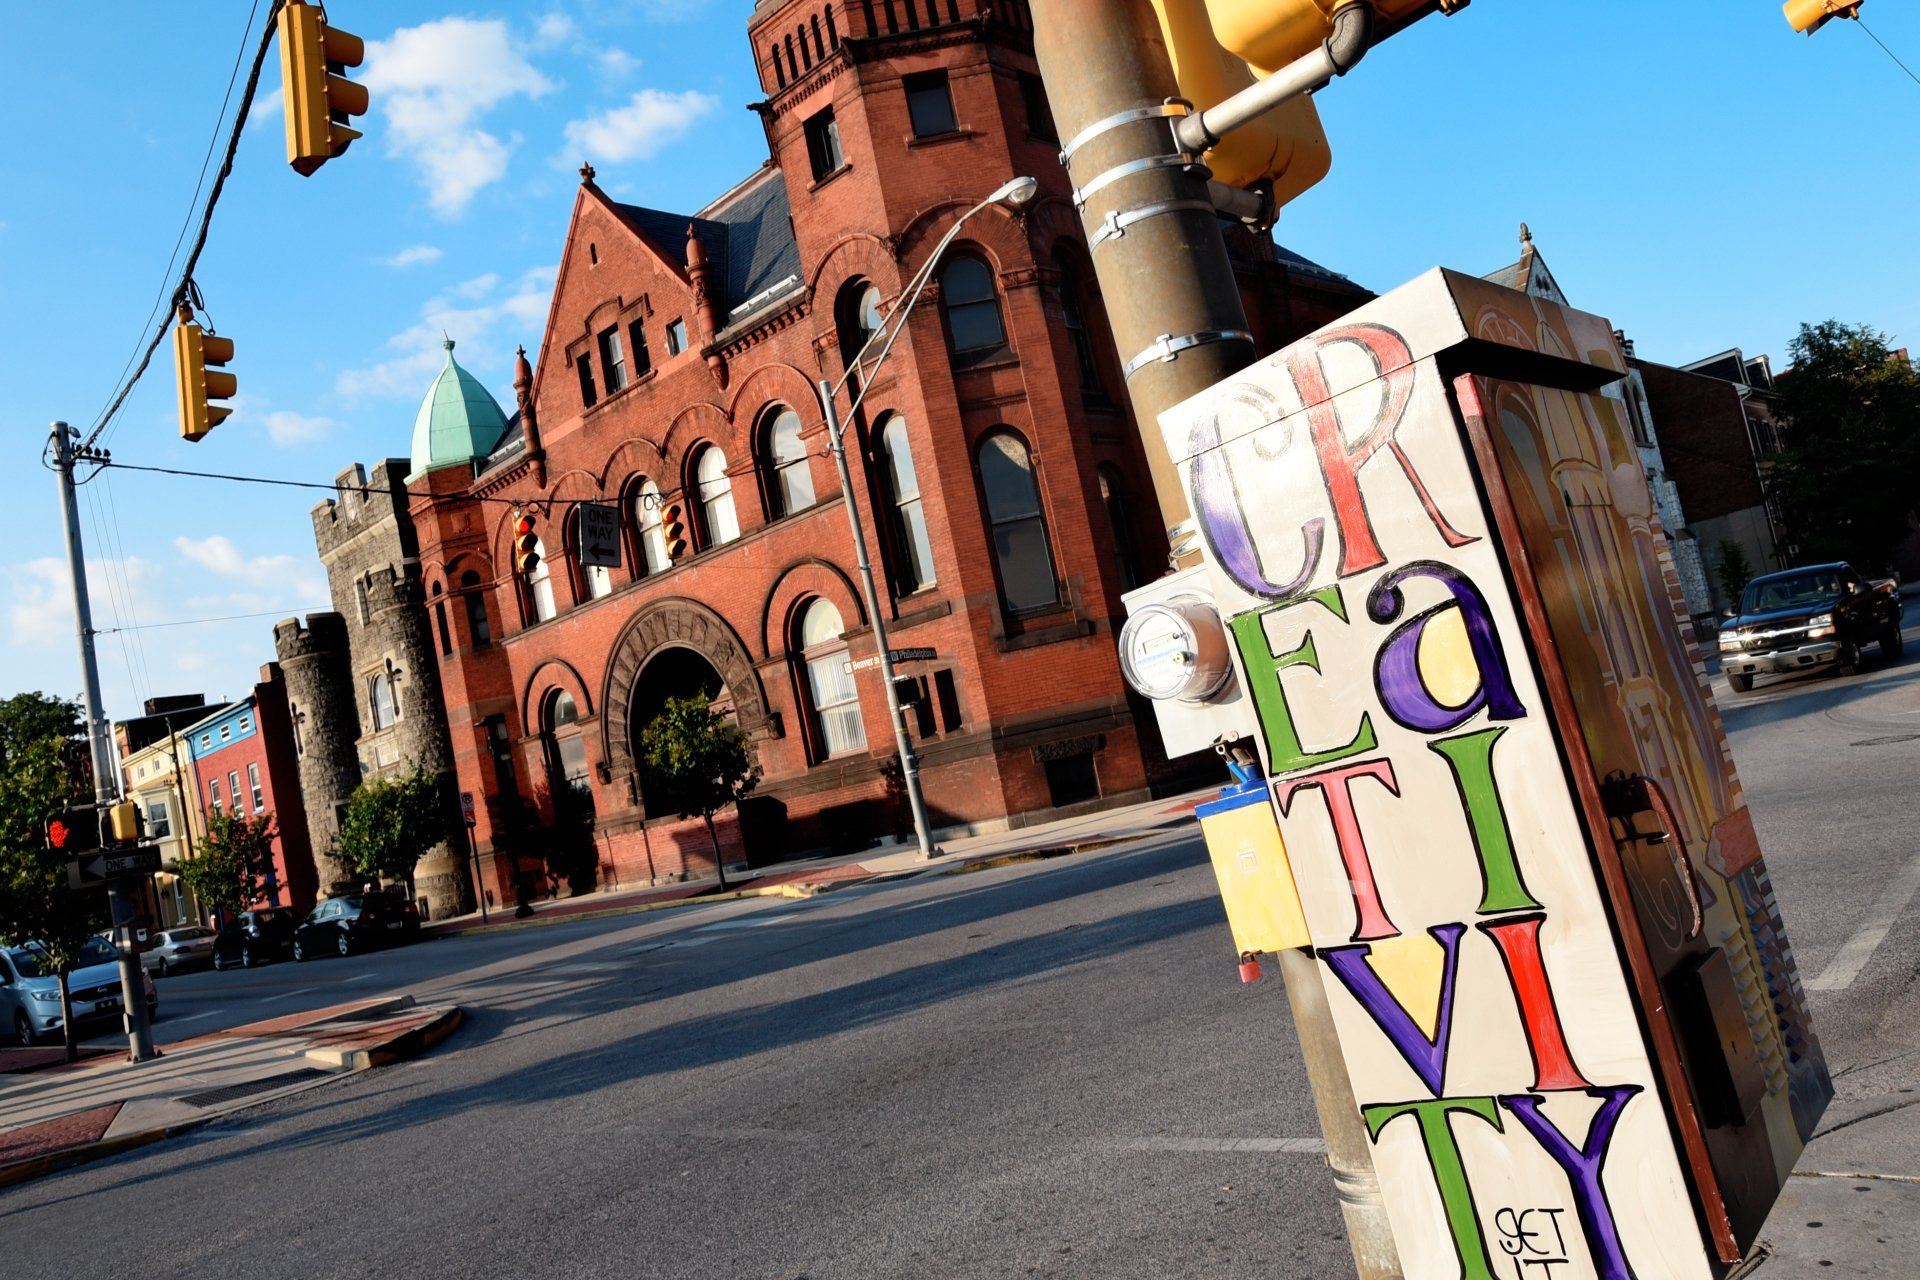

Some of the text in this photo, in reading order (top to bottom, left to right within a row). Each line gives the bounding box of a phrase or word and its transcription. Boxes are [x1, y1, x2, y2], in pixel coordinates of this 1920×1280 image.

[588, 509, 613, 525] ONE
[588, 525, 613, 541] WAY
[852, 657, 873, 670] Beaver
[105, 858, 128, 872] ONE
